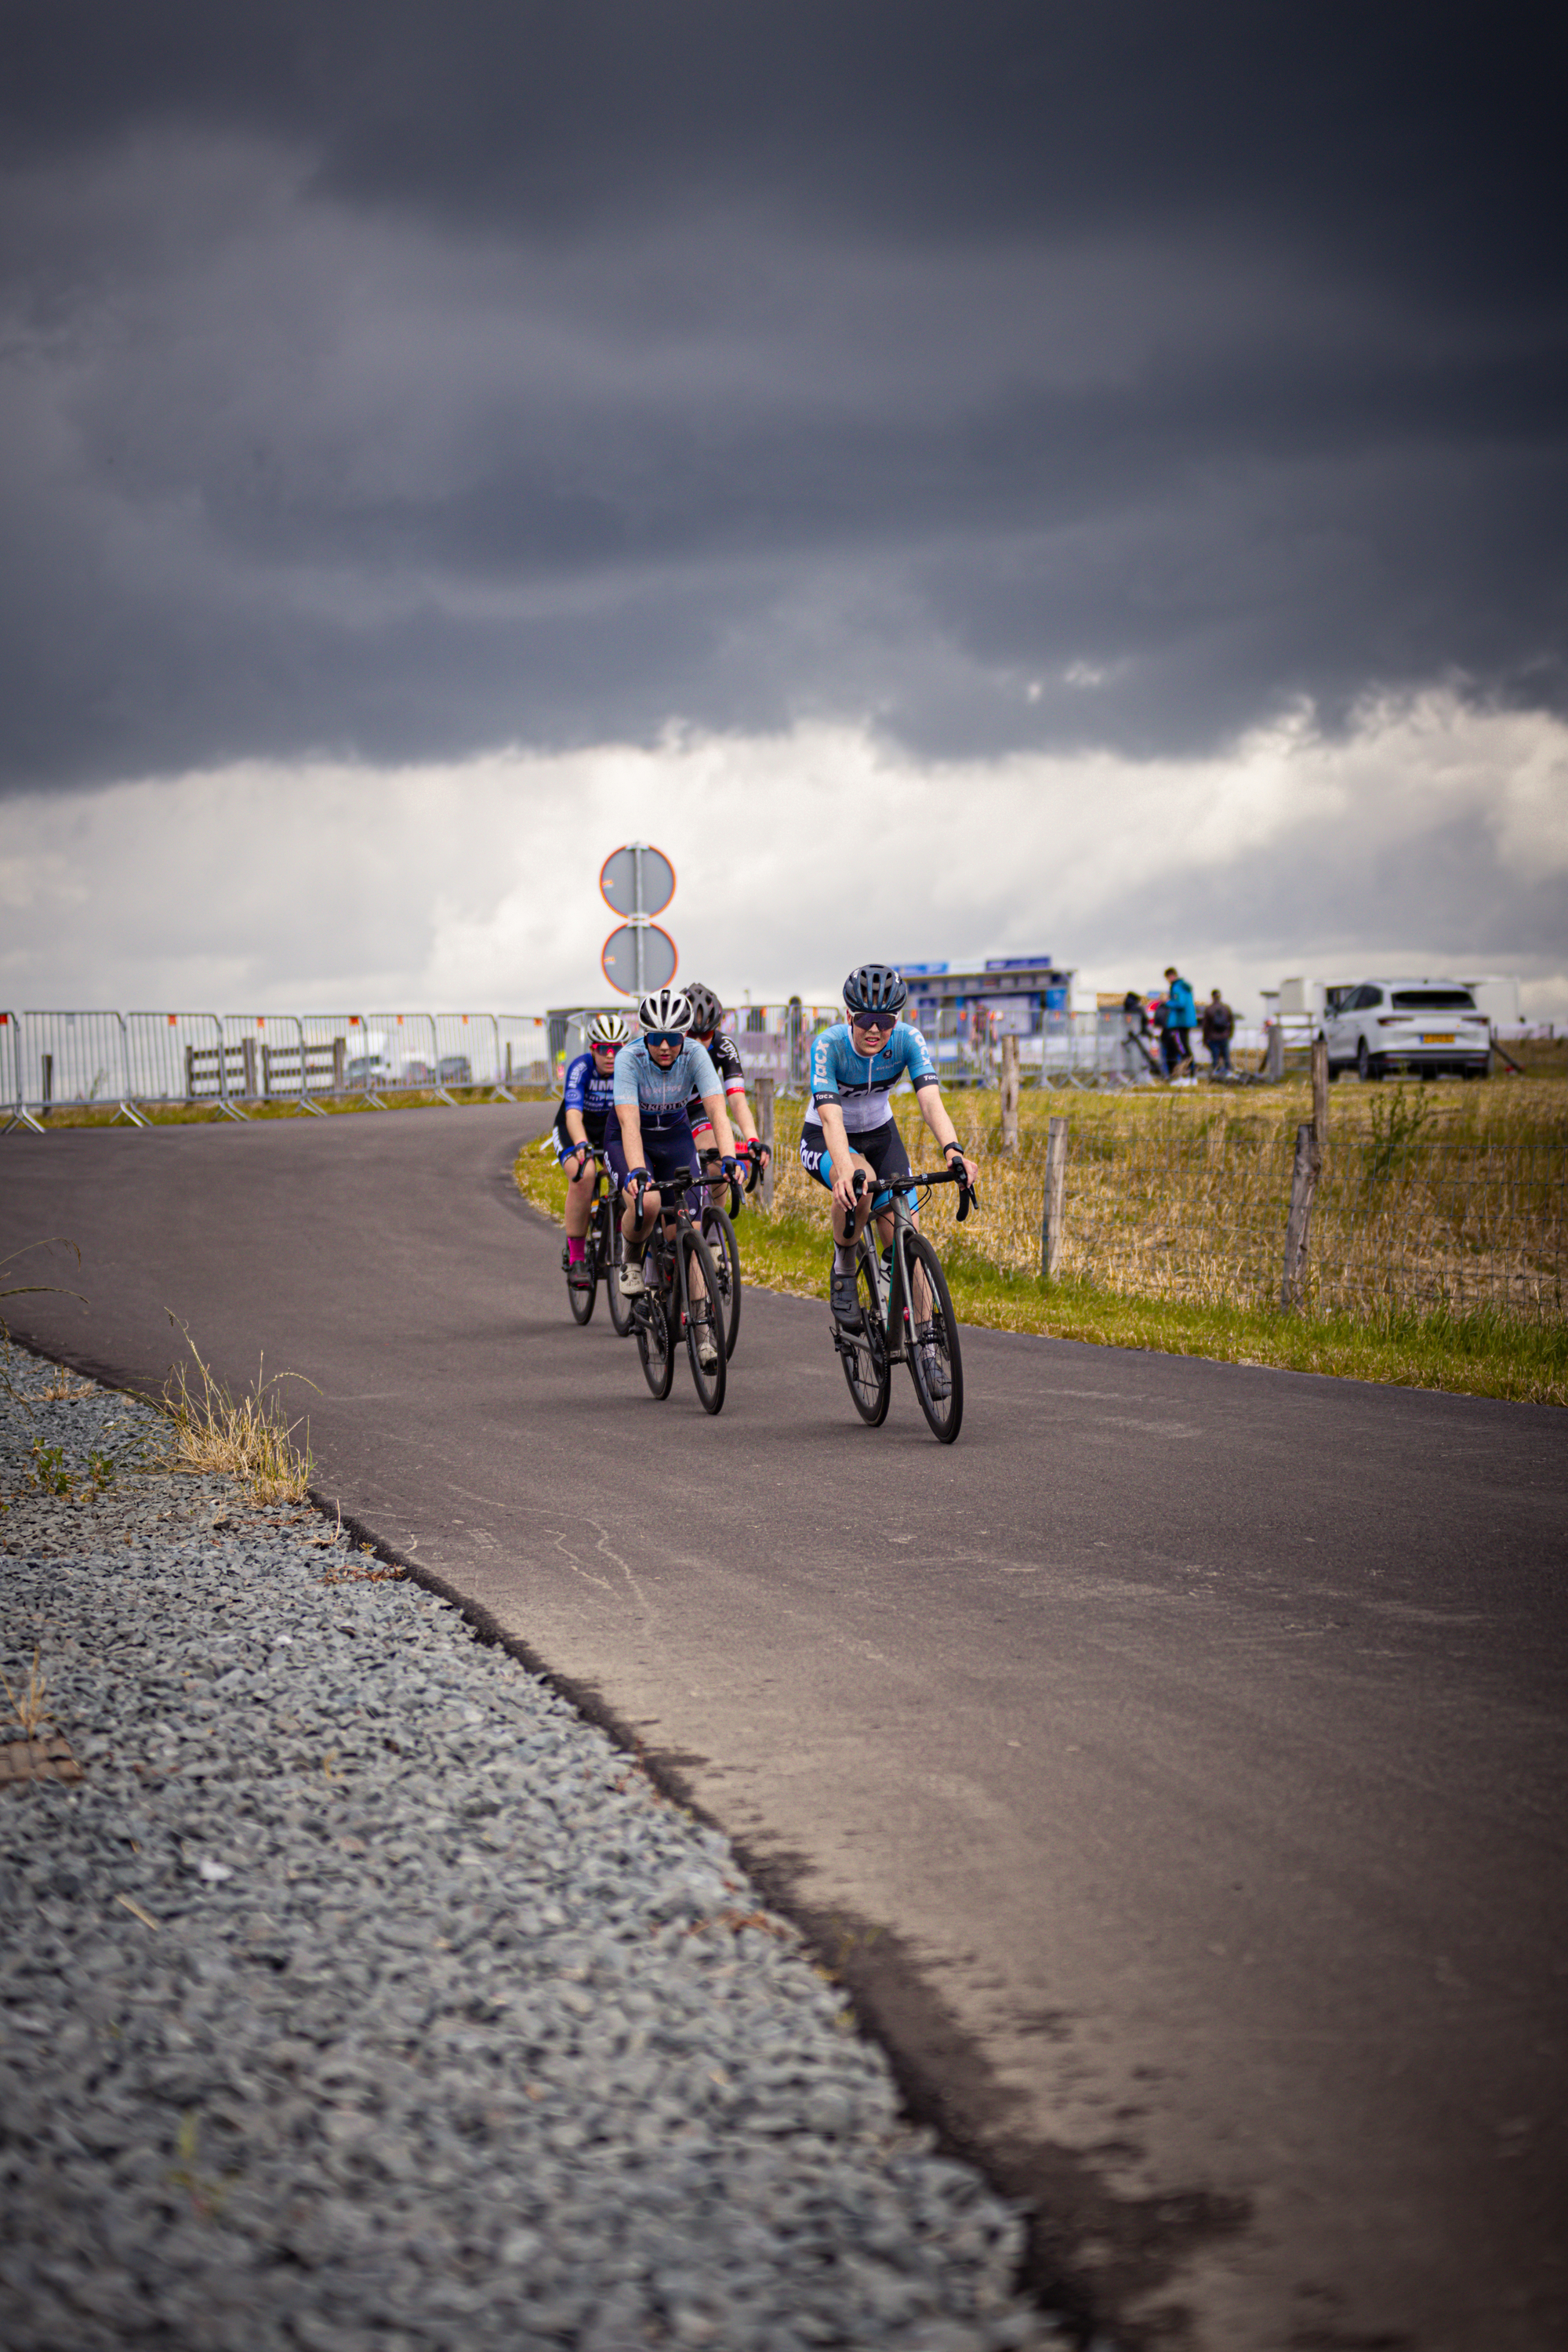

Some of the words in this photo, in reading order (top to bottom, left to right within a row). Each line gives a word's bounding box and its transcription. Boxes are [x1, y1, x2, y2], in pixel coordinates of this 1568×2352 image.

[814, 1040, 829, 1086] Tacx
[909, 1028, 931, 1066] Tacx
[800, 1138, 822, 1171] Tacx
